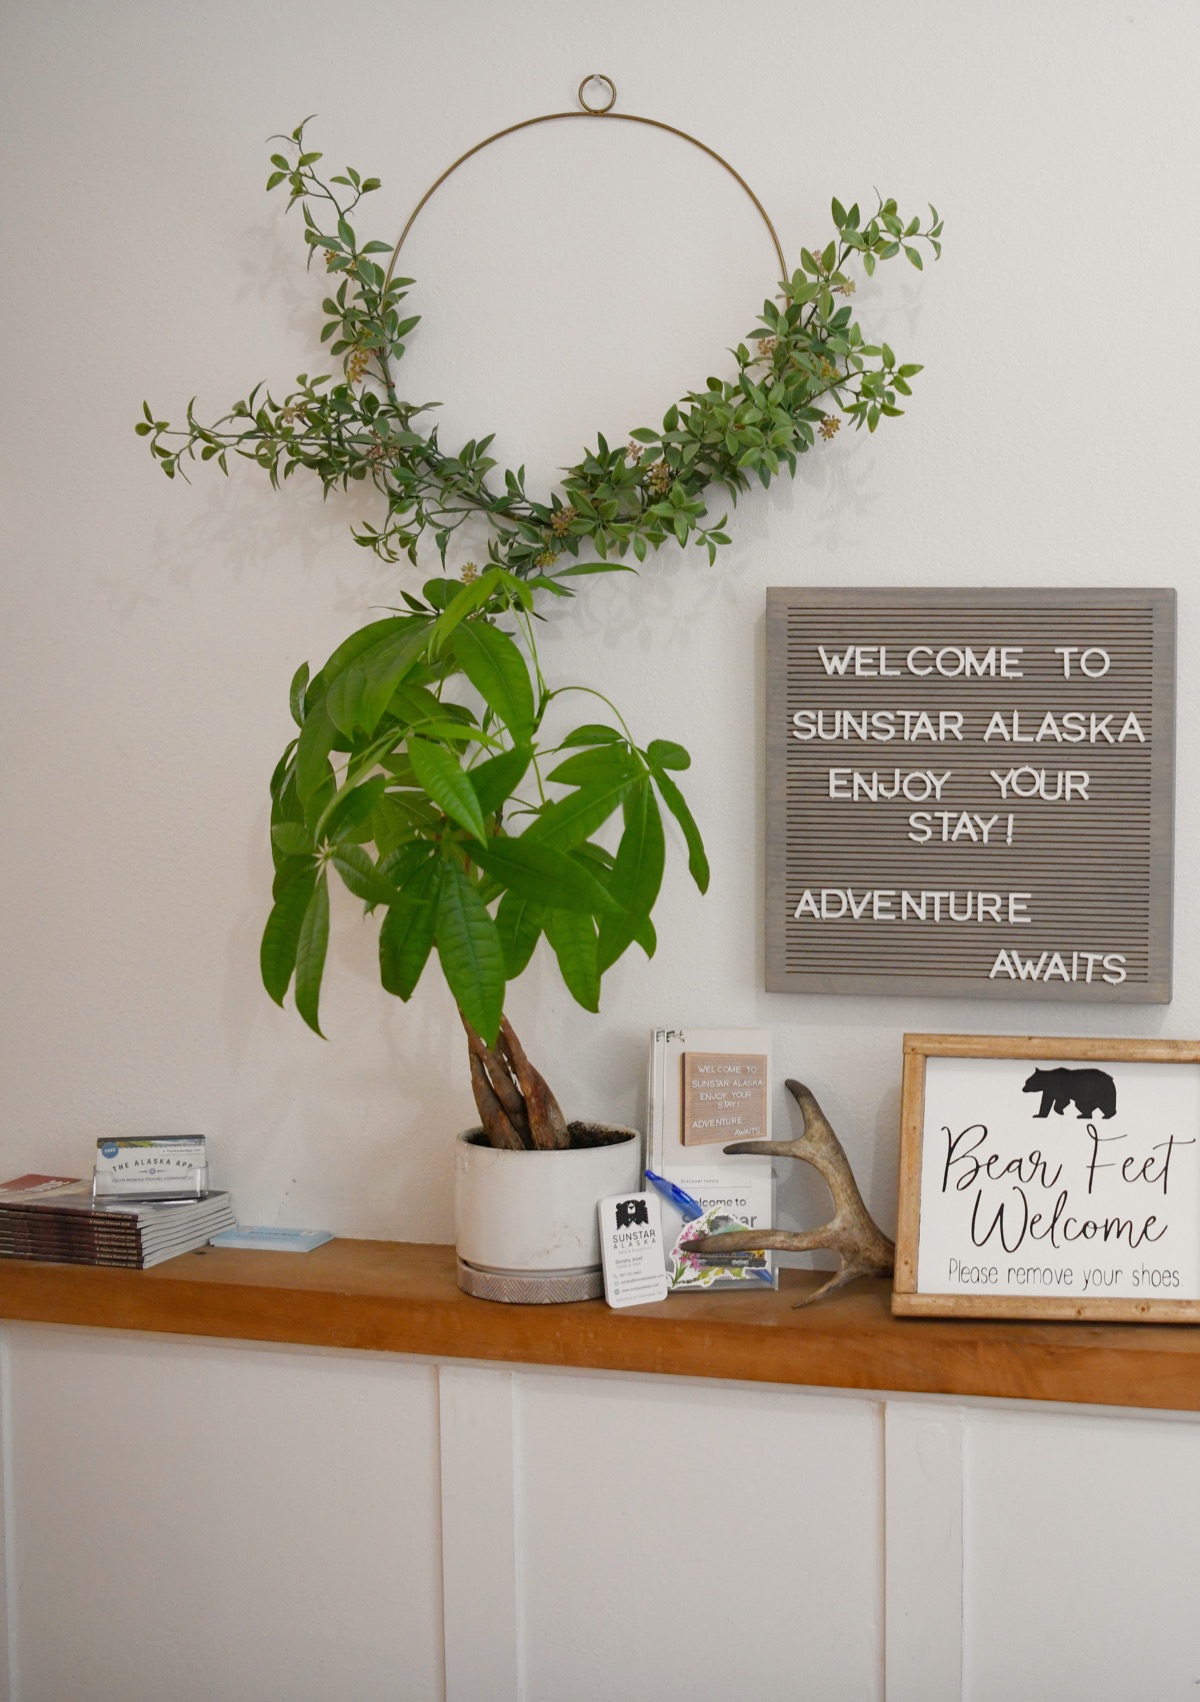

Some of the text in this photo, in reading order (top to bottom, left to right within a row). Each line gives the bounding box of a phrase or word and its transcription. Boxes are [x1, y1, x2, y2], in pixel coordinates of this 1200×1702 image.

[817, 645, 1111, 679] WELCOME TO
[792, 709, 1146, 744] SUNSTAR ALASKA
[828, 764, 1091, 802] ENJOY YOUR
[907, 810, 1015, 846] STAY!
[793, 887, 1032, 924] ADVENTURE
[988, 948, 1127, 986] AWAITS
[697, 1065, 757, 1074] WELCOME TO
[691, 1079, 763, 1088] SUNSTAR ALASKA
[700, 1090, 751, 1101] ENJOY YOUR
[717, 1100, 740, 1109] STAY!
[692, 1117, 742, 1129] ADVENTURE
[734, 1127, 760, 1137] AWAITS
[112, 1158, 193, 1173] THE ALASKA APP
[941, 1123, 1196, 1194] Bear Feet
[694, 1197, 747, 1207] elcome to
[970, 1186, 1168, 1253] Welcome
[612, 1229, 656, 1244] SUNSTAR
[613, 1237, 657, 1250] ALASKA
[949, 1257, 1184, 1291] Please remove your shoes.
